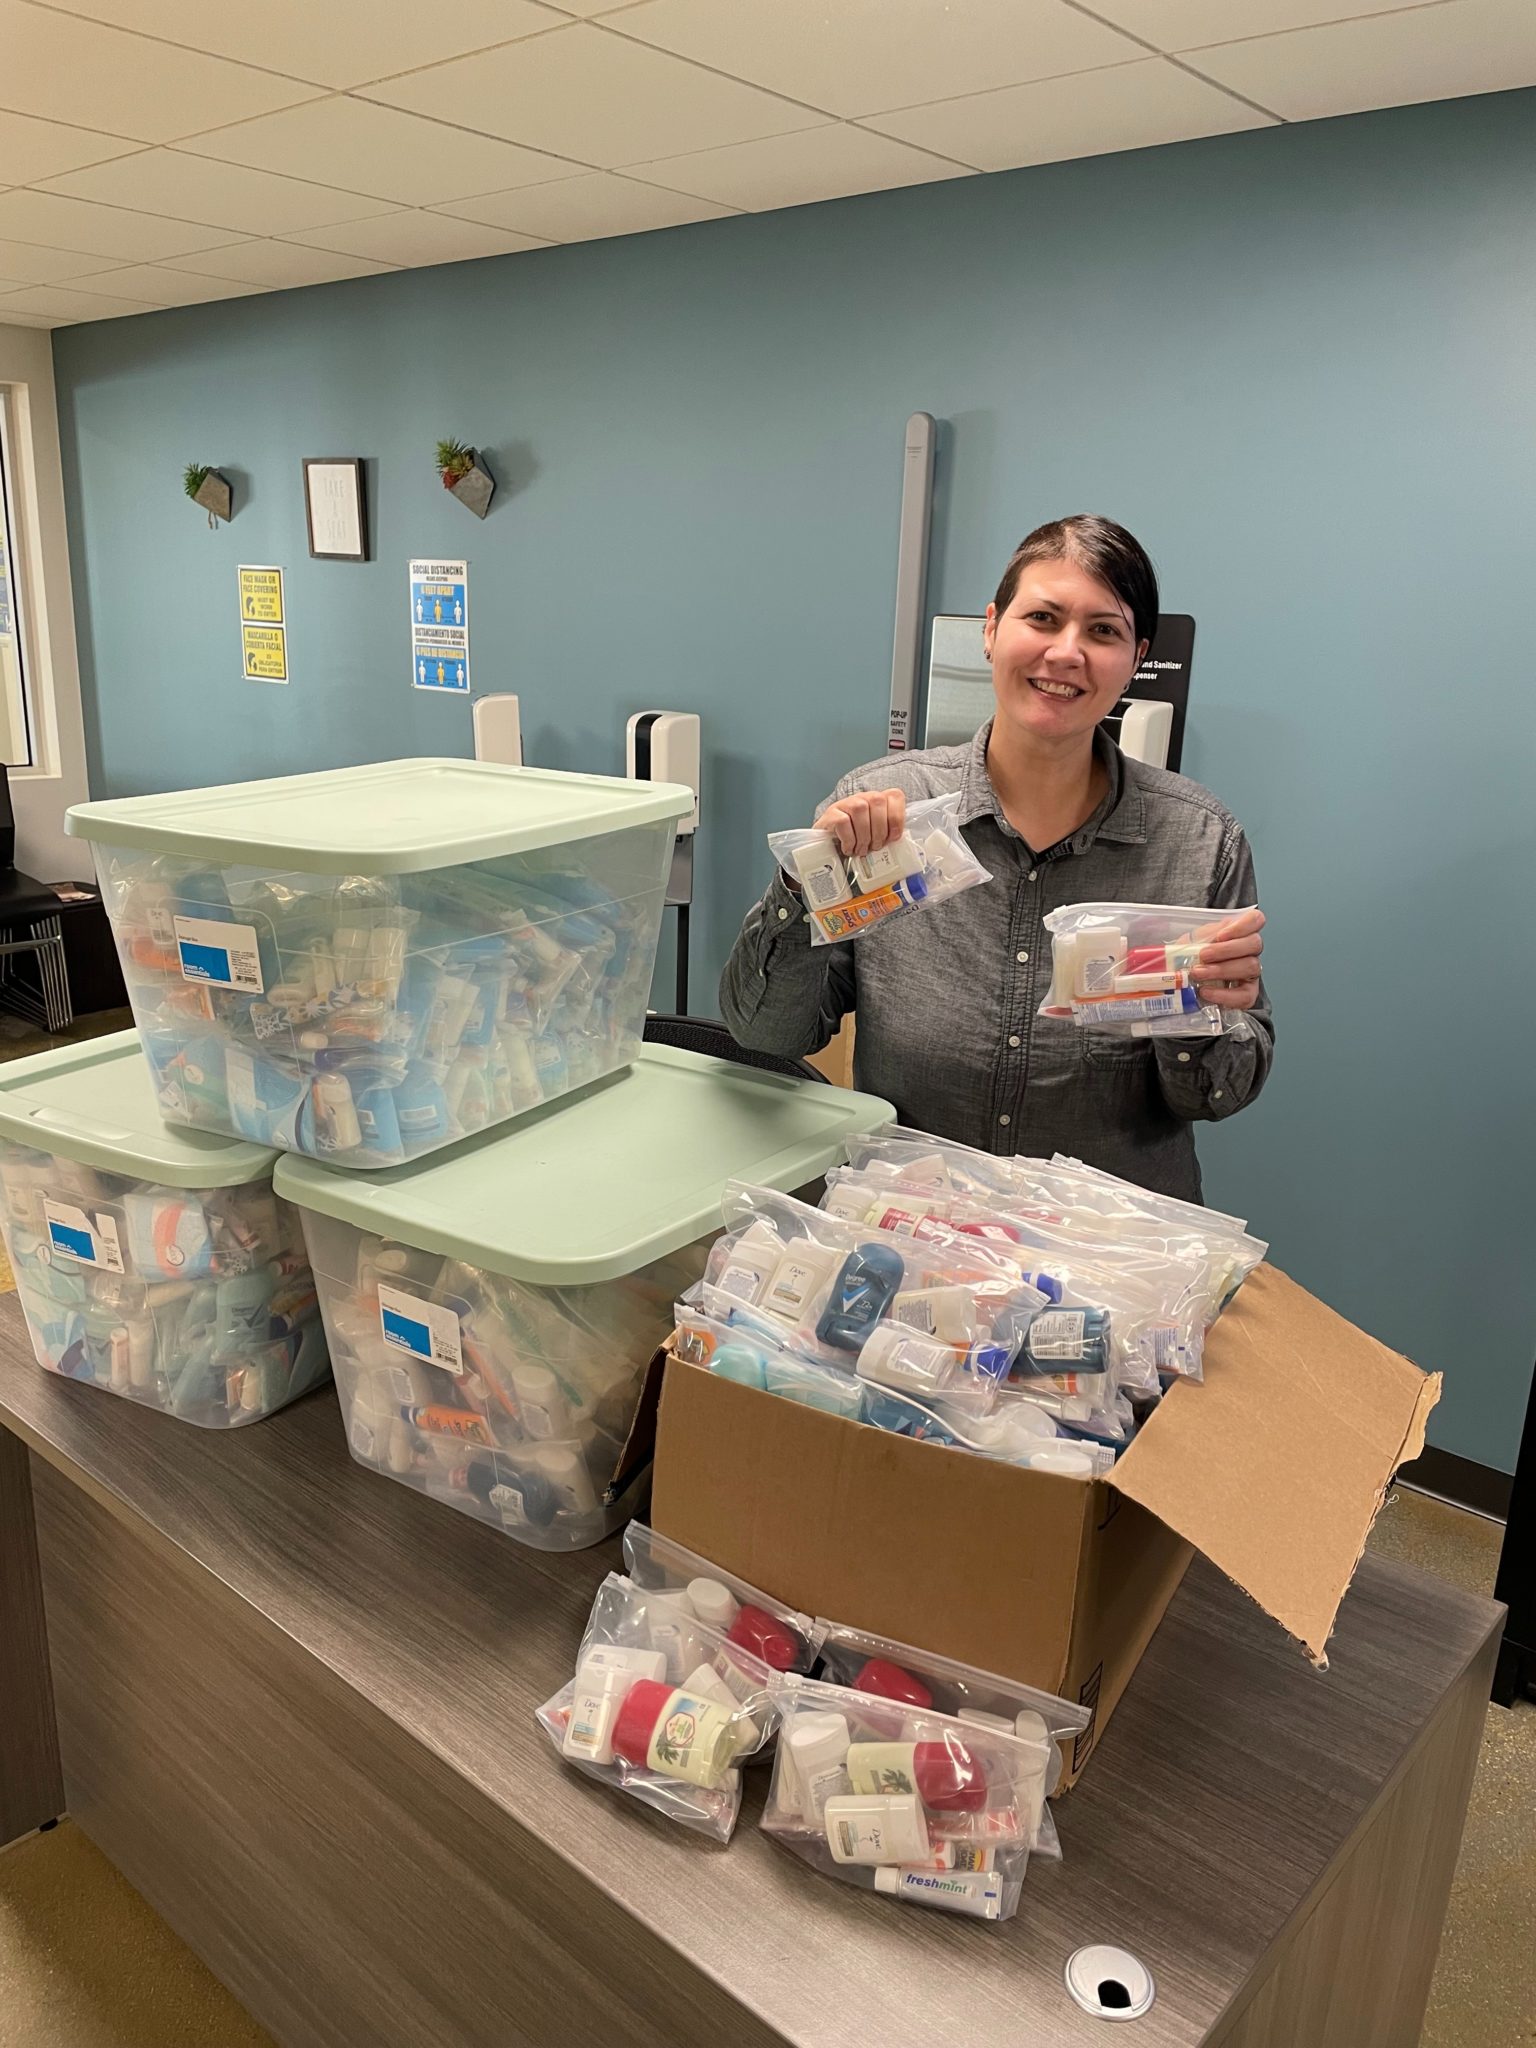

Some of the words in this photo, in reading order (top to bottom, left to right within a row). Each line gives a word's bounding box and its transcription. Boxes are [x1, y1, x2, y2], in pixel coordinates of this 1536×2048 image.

[412, 565, 430, 575] SOCIAL
[431, 565, 464, 576] DISTANCING
[243, 575, 253, 583] FACE
[254, 576, 267, 584] MASK
[268, 576, 276, 584] OR
[243, 584, 253, 593] FACE
[254, 585, 278, 594] COVERING
[450, 629, 465, 640] SOCIAL
[1153, 660, 1183, 670] Sanitizer
[890, 710, 908, 719] POP-UP
[890, 720, 906, 728] SAFETY
[789, 1265, 806, 1278] Dove
[845, 1273, 867, 1283] Degree
[584, 1699, 602, 1710] Dove
[872, 1827, 882, 1850] Dove
[906, 1873, 968, 1895] freshmint
